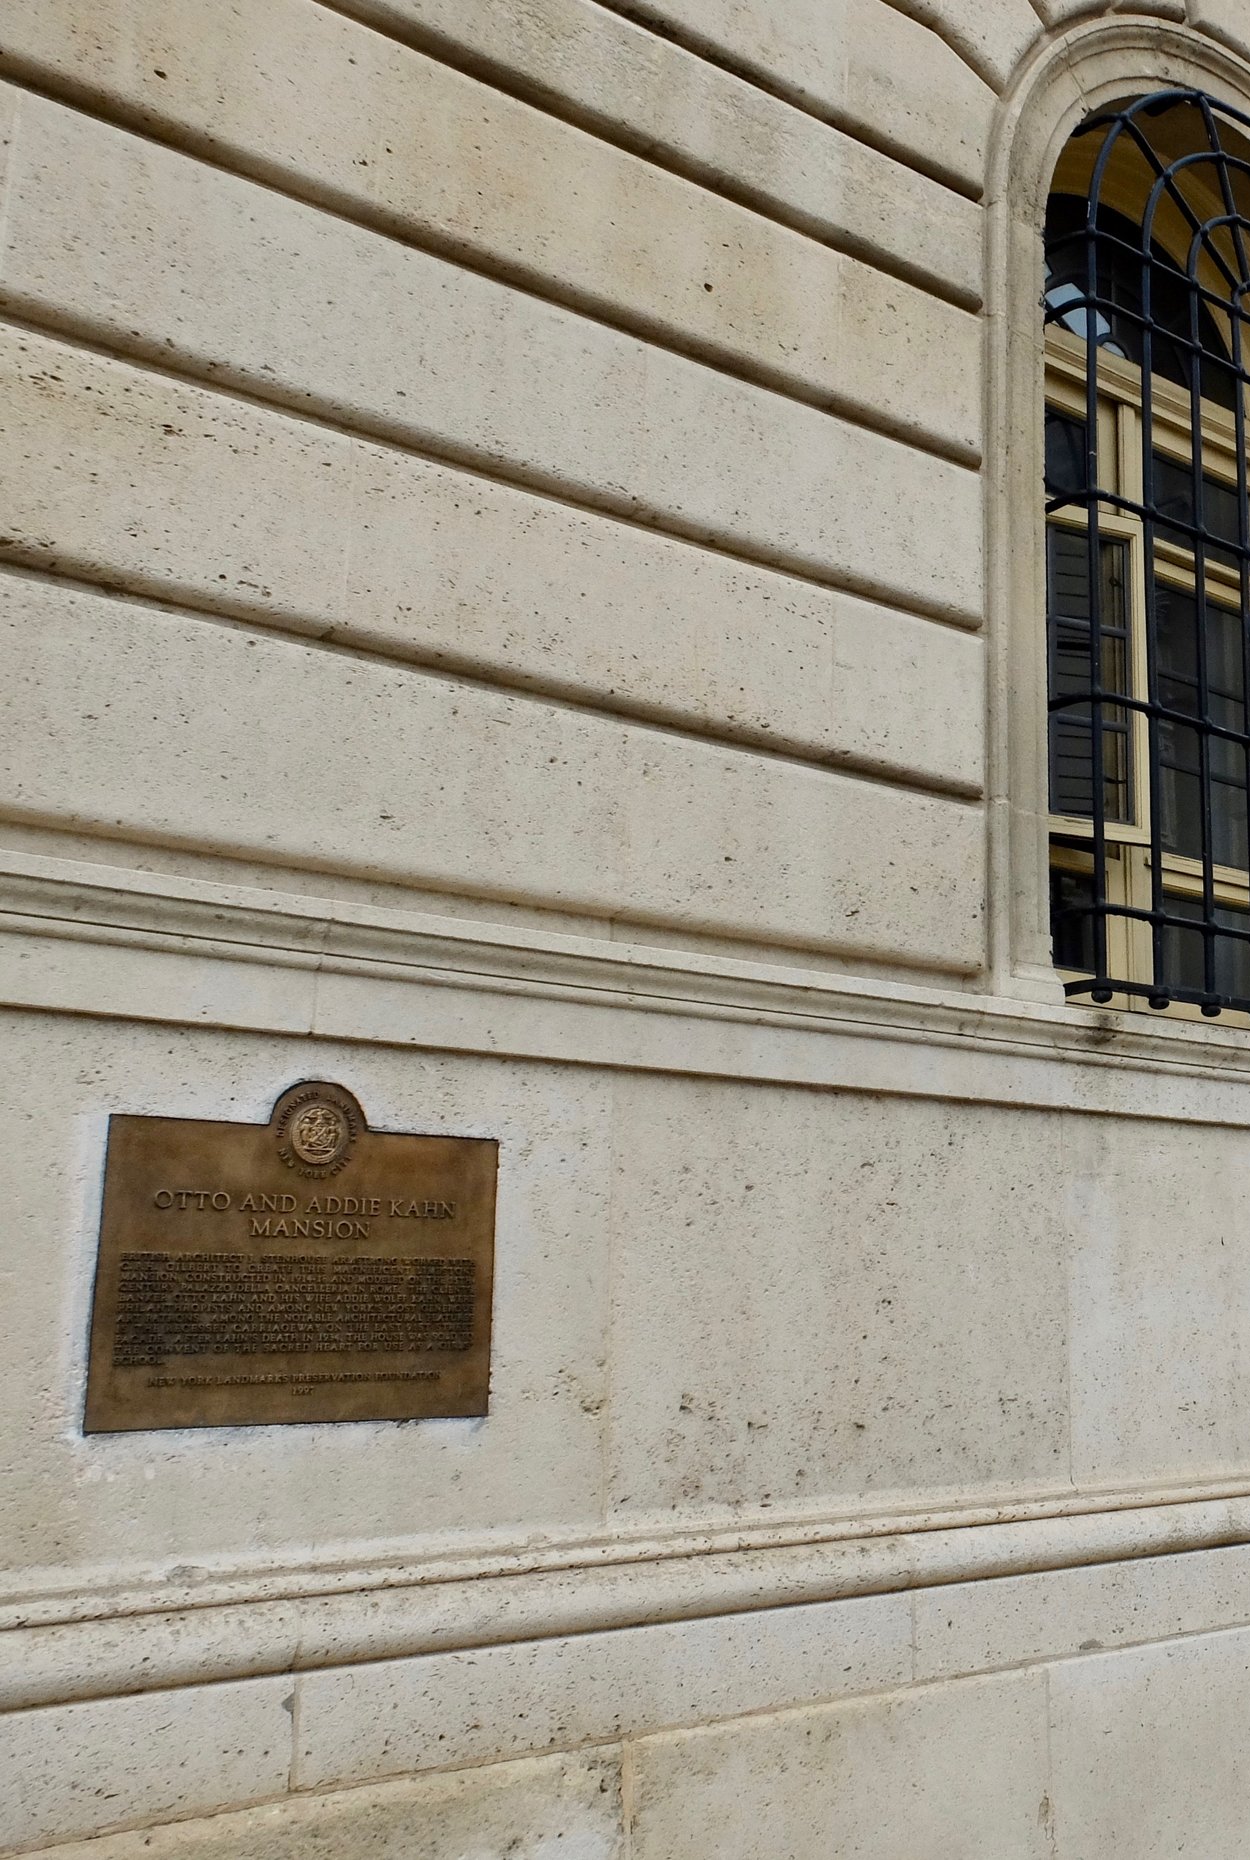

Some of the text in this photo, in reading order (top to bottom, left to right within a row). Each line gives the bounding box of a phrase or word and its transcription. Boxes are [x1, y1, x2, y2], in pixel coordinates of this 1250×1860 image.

[155, 1190, 457, 1219] OTTO AND ADDIE KAHN
[249, 1217, 370, 1240] MANSION
[120, 1252, 170, 1262] BRITISH
[176, 1253, 244, 1263] ARCHITECT
[261, 1254, 328, 1264] STENHOUSE
[334, 1255, 398, 1265] ARMSTRONG
[166, 1263, 220, 1273] GILBERT
[224, 1263, 242, 1273] TO
[248, 1264, 294, 1273] CREATE
[299, 1264, 327, 1274] THIS
[333, 1265, 414, 1275] MAGNIFICENT
[185, 1273, 270, 1283] CONSTRUCTED
[274, 1274, 287, 1283] IN
[331, 1274, 354, 1284] AND
[358, 1274, 405, 1284] MODELED
[408, 1275, 422, 1285] ON
[424, 1275, 446, 1285] THE
[118, 1283, 175, 1292] CENTURY
[180, 1283, 231, 1293] PALAZZO
[236, 1284, 271, 1293] DELLA
[275, 1284, 349, 1294] CANCELLERIA
[354, 1284, 366, 1294] IN
[407, 1285, 429, 1294] THE
[117, 1293, 169, 1303] BANKER
[173, 1294, 208, 1303] OTTO
[211, 1294, 246, 1303] KAHN
[250, 1294, 277, 1303] AND
[281, 1294, 301, 1303] HIS
[305, 1294, 332, 1303] WIFE
[335, 1294, 370, 1304] ADDIE
[373, 1295, 408, 1304] WOLFF
[449, 1295, 475, 1304] WERE
[116, 1303, 475, 1313] PHILANTHROPISTS AND AMONG NEW YORK'S MOST GENEROUS
[116, 1314, 141, 1324] ART
[211, 1314, 255, 1323] AMONG
[259, 1314, 281, 1323] THE
[284, 1313, 334, 1323] NOTABLE
[335, 1313, 423, 1323] ARCHITECTURAL
[425, 1313, 475, 1322] FEATURES
[134, 1324, 160, 1334] THE
[164, 1324, 228, 1334] RECESSED
[233, 1323, 322, 1333] CARRIAGEWAY
[326, 1323, 343, 1333] ON
[347, 1323, 370, 1332] THE
[374, 1323, 402, 1332] EAST
[406, 1323, 432, 1332] 91ST
[437, 1322, 475, 1332] STREET
[173, 1334, 211, 1344] AFTER
[215, 1334, 259, 1344] KAHN'S
[261, 1333, 298, 1343] DEATH
[302, 1333, 314, 1343] IN
[345, 1333, 367, 1342] THE
[370, 1333, 405, 1342] HOUSE
[408, 1333, 430, 1342] WAS
[432, 1333, 458, 1341] SOLD
[460, 1333, 474, 1341] TO
[112, 1345, 140, 1355] THE
[145, 1344, 209, 1355] CONVENT
[213, 1344, 229, 1354] OF
[234, 1344, 258, 1354] THE
[262, 1343, 310, 1353] SACRED
[314, 1343, 353, 1353] HEART
[357, 1342, 379, 1352] FOR
[383, 1342, 405, 1352] USE
[407, 1342, 423, 1352] AS
[425, 1342, 433, 1352] A
[147, 1370, 442, 1388] NEW YORK LANDMARKS PRESERVATION FOUNDATION
